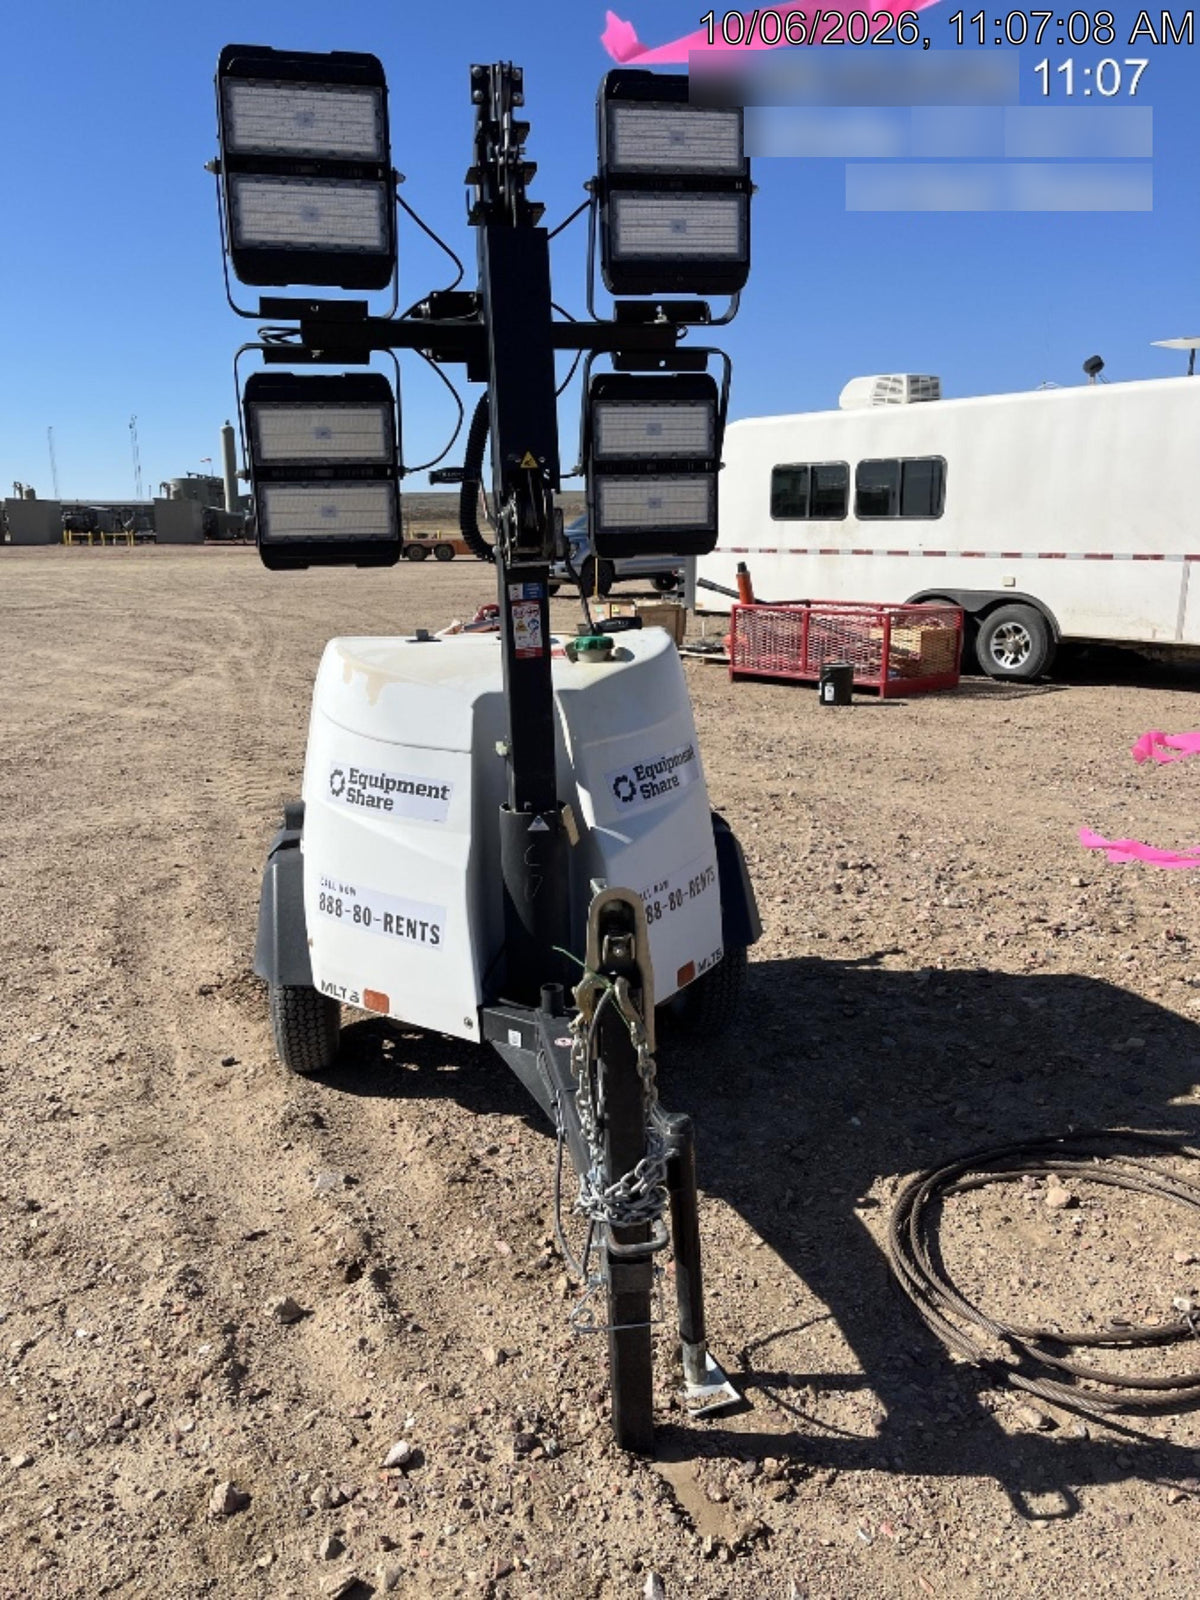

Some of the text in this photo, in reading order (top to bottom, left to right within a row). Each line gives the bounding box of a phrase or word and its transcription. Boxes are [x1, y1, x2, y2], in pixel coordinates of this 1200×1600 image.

[633, 744, 696, 782] Equipment
[345, 787, 394, 811] Share
[347, 767, 451, 800] Equipment
[640, 775, 680, 800] Share
[319, 891, 441, 946] 888-80-RENTS
